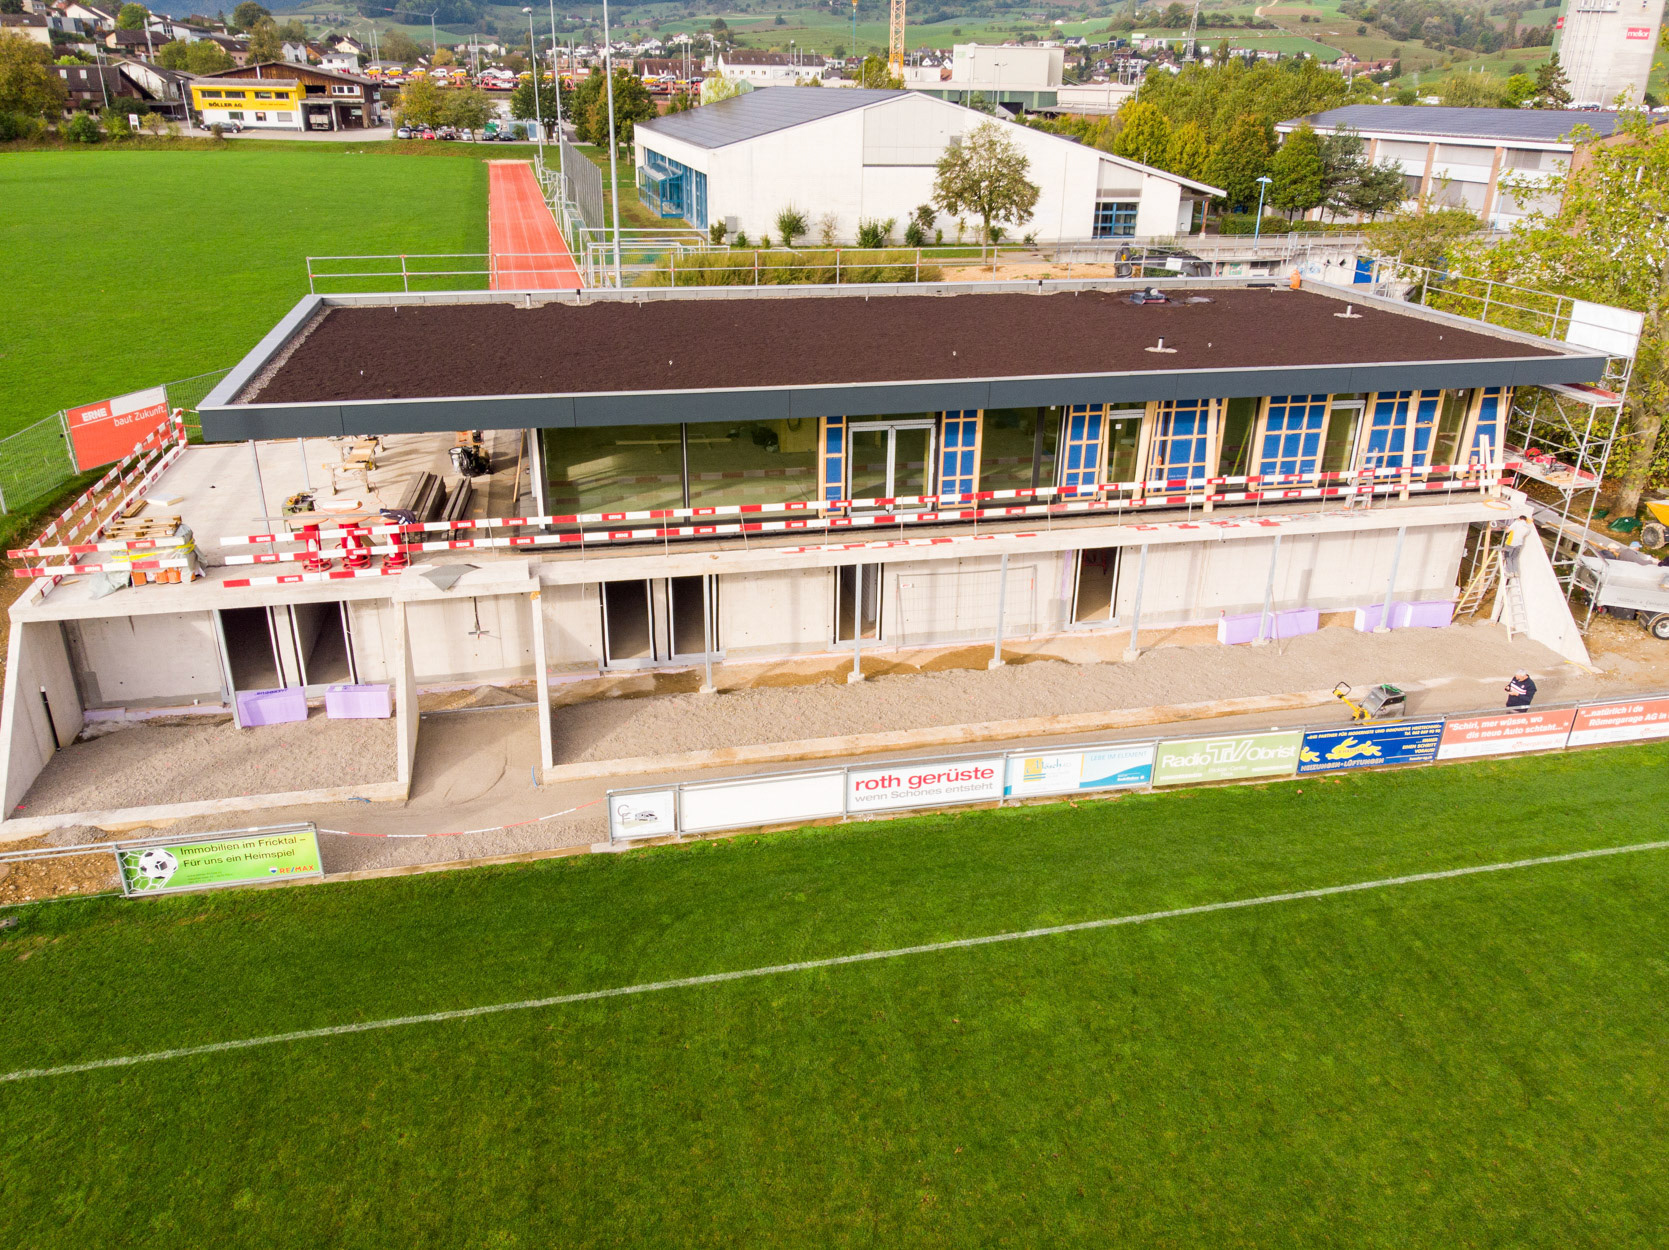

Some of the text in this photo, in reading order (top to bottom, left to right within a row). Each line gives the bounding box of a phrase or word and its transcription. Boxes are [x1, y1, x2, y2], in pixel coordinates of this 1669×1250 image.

[81, 408, 107, 422] ERNE
[113, 405, 167, 427] baut Zukunft.
[1481, 720, 1498, 728] mer
[1645, 712, 1658, 721] AG
[1503, 726, 1523, 735] Auto
[1162, 740, 1296, 769] Radio TV Obrist
[855, 767, 994, 791] roth gerüste
[855, 782, 993, 802] wenn Schönes entsteht
[180, 843, 240, 856] Immobilien
[242, 841, 256, 850] im
[258, 836, 297, 848] Fricktal
[183, 848, 295, 868] Für uns ein Heimspiel
[279, 865, 315, 875] RE/MAX
